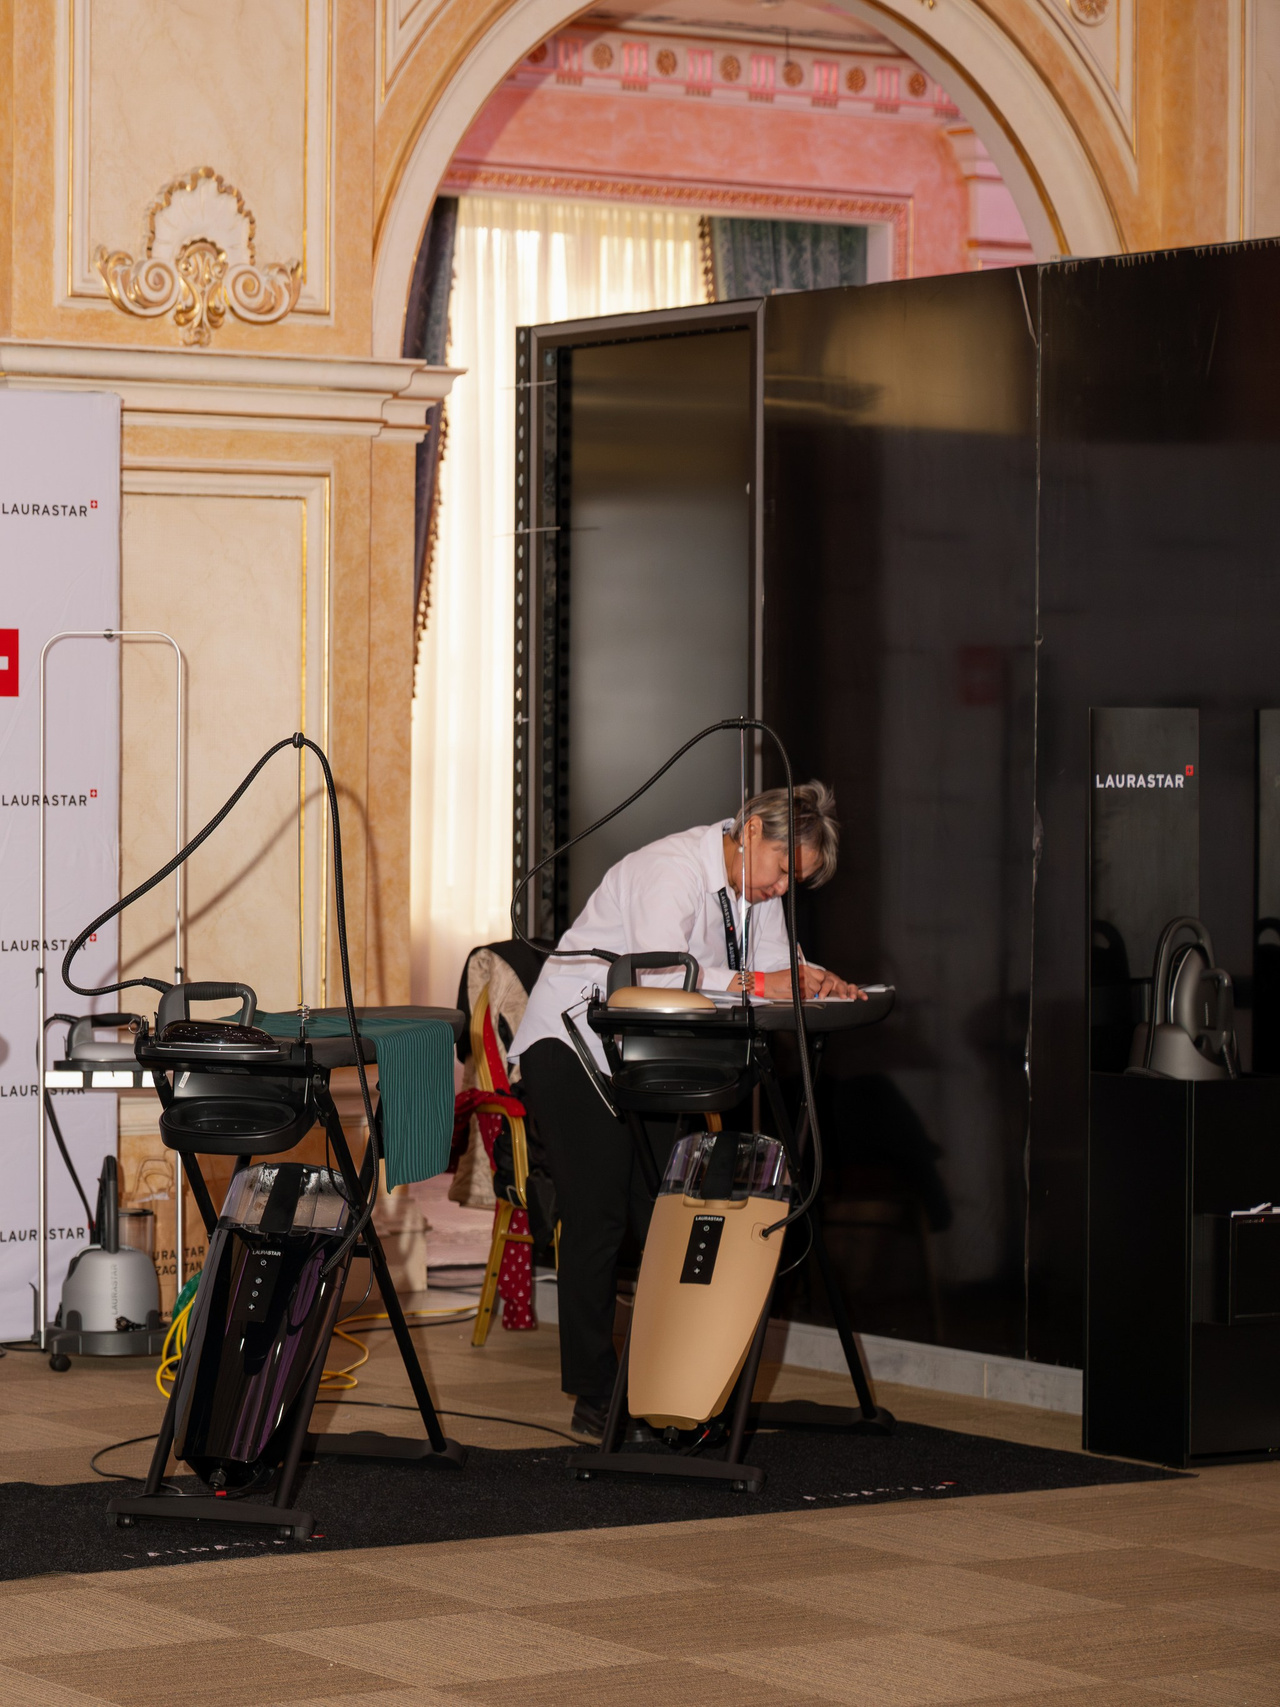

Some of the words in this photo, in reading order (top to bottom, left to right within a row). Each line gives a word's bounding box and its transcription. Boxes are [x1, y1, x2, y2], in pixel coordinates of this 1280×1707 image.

[2, 504, 87, 516] LAURASTAR
[1096, 773, 1184, 789] LAURASTAR
[0, 1227, 85, 1243] LAURSTAR
